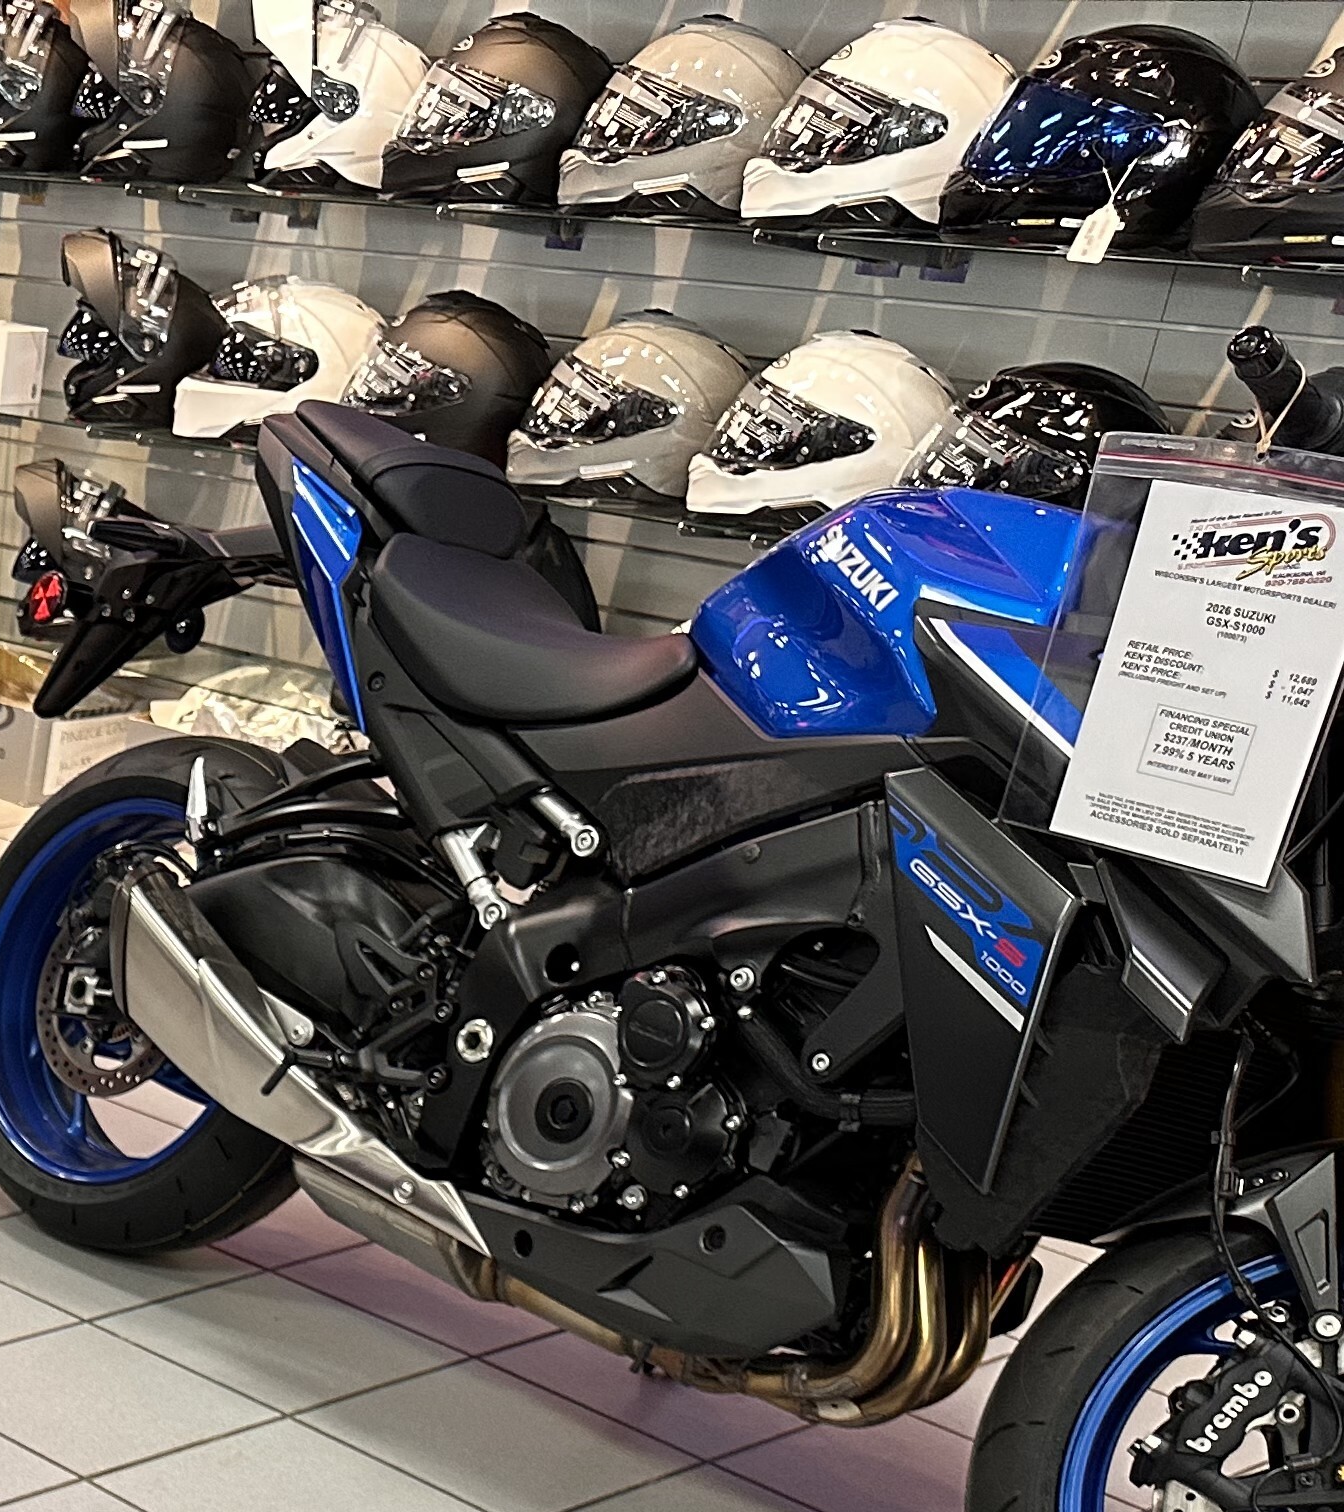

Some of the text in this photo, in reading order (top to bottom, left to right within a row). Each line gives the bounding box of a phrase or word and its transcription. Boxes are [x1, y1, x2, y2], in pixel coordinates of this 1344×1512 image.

[1196, 518, 1323, 559] ken's
[1235, 545, 1328, 581] Sports
[1205, 579, 1242, 592] LARGEST
[1242, 585, 1302, 603] MOTORSPORTS
[1205, 602, 1276, 624] 2026 SUZUKI
[1206, 616, 1266, 636] GSX-S1000
[1124, 650, 1153, 663] KEN'S
[1153, 656, 1205, 674] DISCOUNT:
[1268, 679, 1276, 689] $
[1127, 640, 1160, 654] RETAIL
[1162, 646, 1194, 660] PRICE:
[1272, 669, 1279, 679] $
[1121, 660, 1150, 673] KEN'S
[1265, 690, 1273, 700] $
[1201, 687, 1214, 695] SET
[1159, 709, 1251, 736] FINANCING SPECIAL
[1169, 722, 1235, 744] CREDIT UNION
[1152, 743, 1236, 772] 7.99% 5 YEARS
[1163, 732, 1234, 757] $237/MONTH
[1089, 809, 1154, 832] ACCESSORIES
[1154, 825, 1180, 839] SOLD
[909, 858, 1028, 968] GSX-S
[980, 950, 1027, 996] 1000
[1185, 1370, 1273, 1453] brembo
